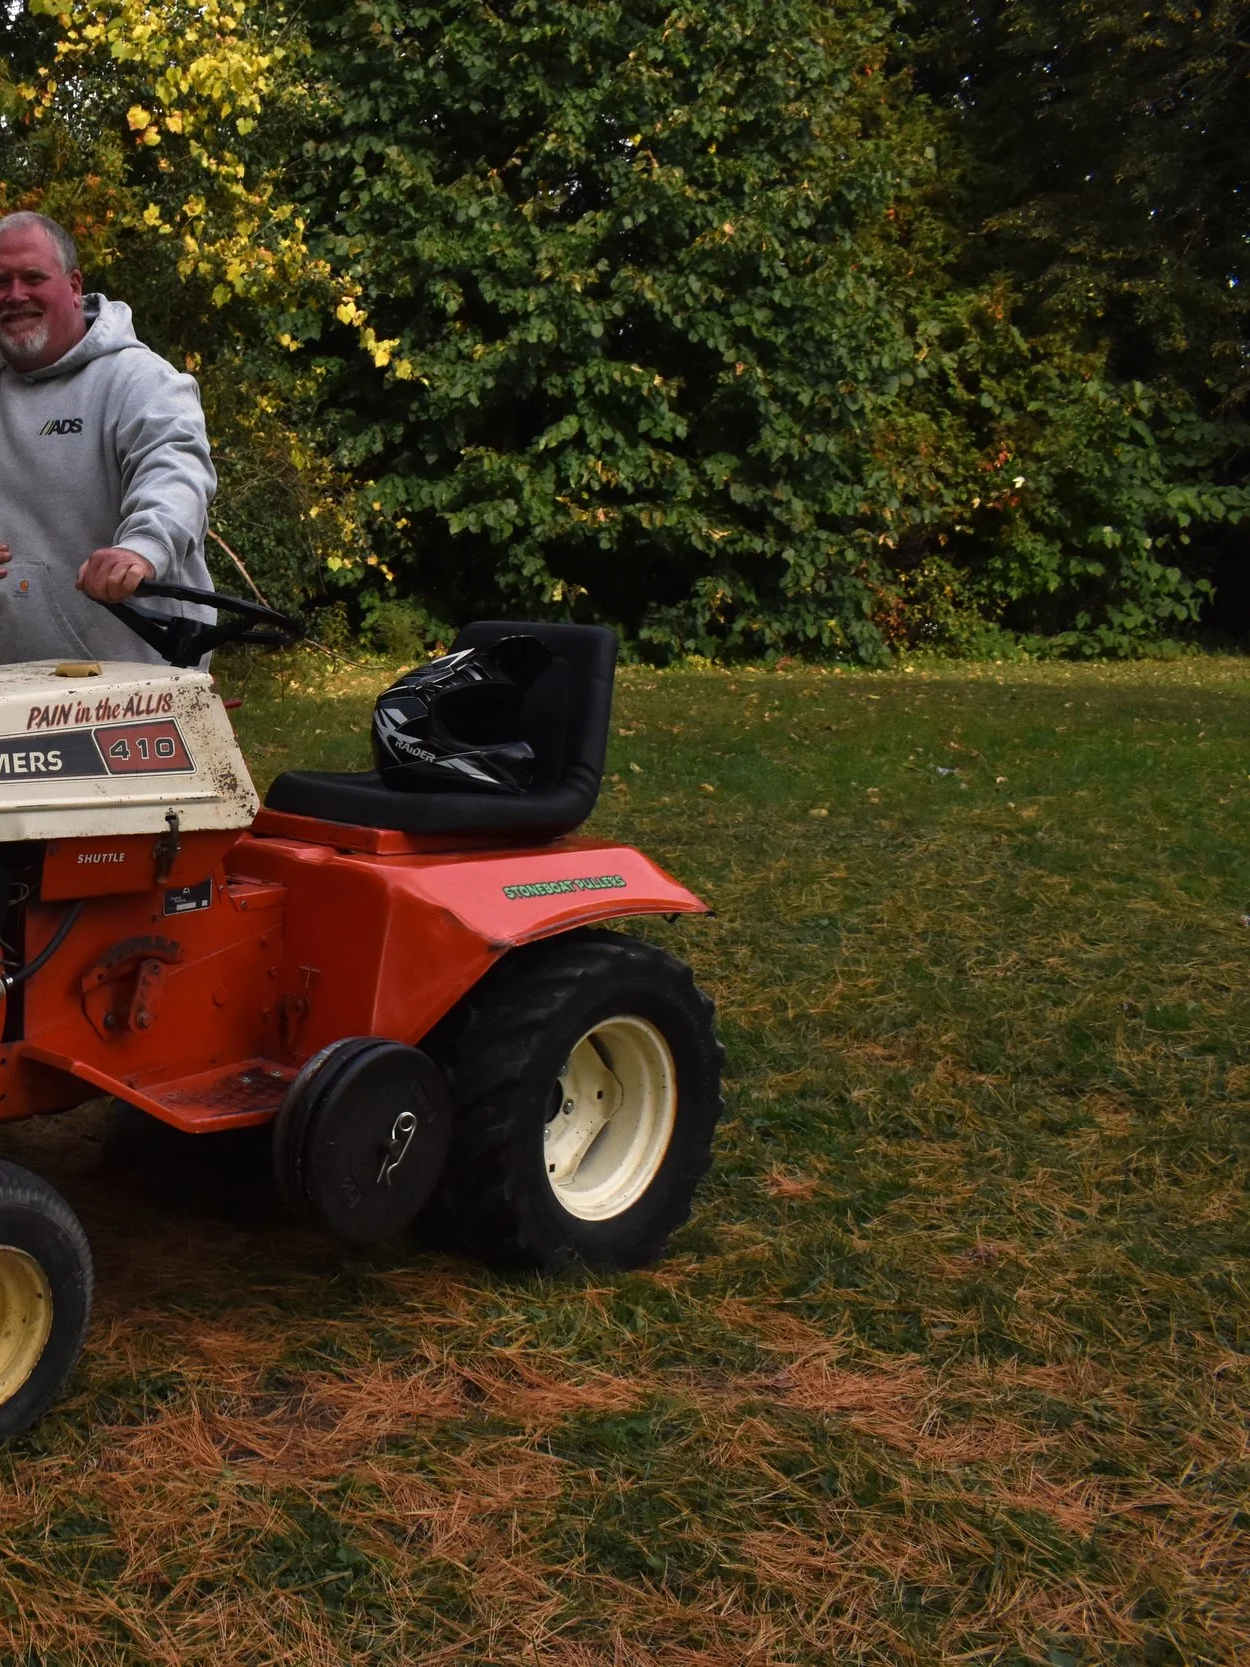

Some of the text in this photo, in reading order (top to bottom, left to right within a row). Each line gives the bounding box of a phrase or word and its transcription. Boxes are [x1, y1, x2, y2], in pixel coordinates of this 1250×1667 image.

[27, 692, 174, 730] PAIN in the ALLIS
[109, 737, 175, 761] 410
[394, 739, 437, 763] RAIDER
[77, 852, 126, 864] SHUTTLE
[502, 875, 627, 900] STONEBOAT PULLERS
